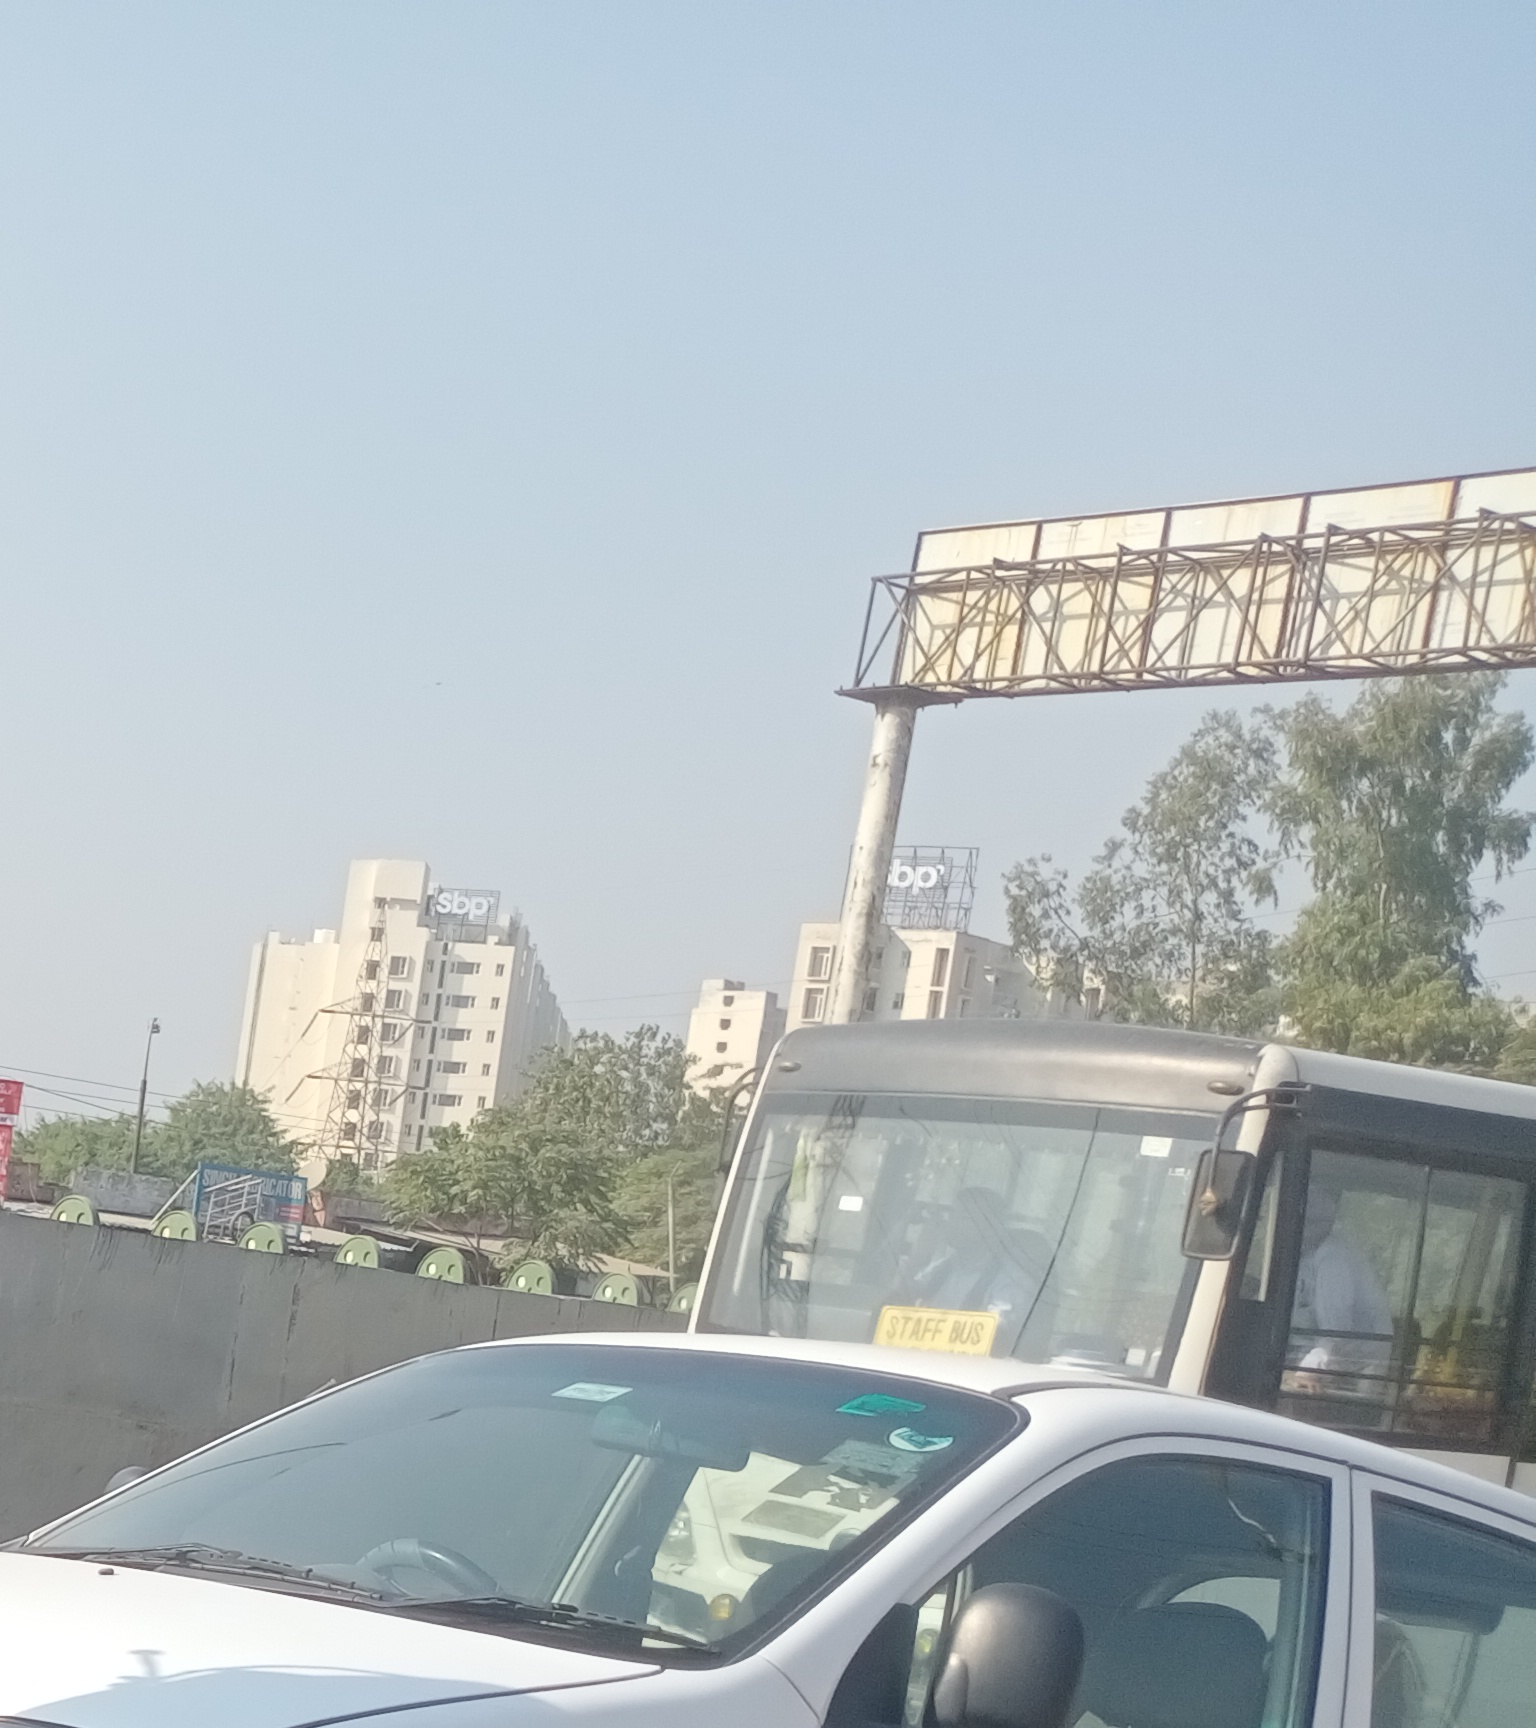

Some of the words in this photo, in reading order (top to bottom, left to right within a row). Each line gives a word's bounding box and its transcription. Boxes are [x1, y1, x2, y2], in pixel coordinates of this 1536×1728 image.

[887, 859, 938, 895] bp
[436, 889, 489, 921] sbp
[886, 1315, 948, 1342] STAFF
[948, 1320, 984, 1345] BUS
